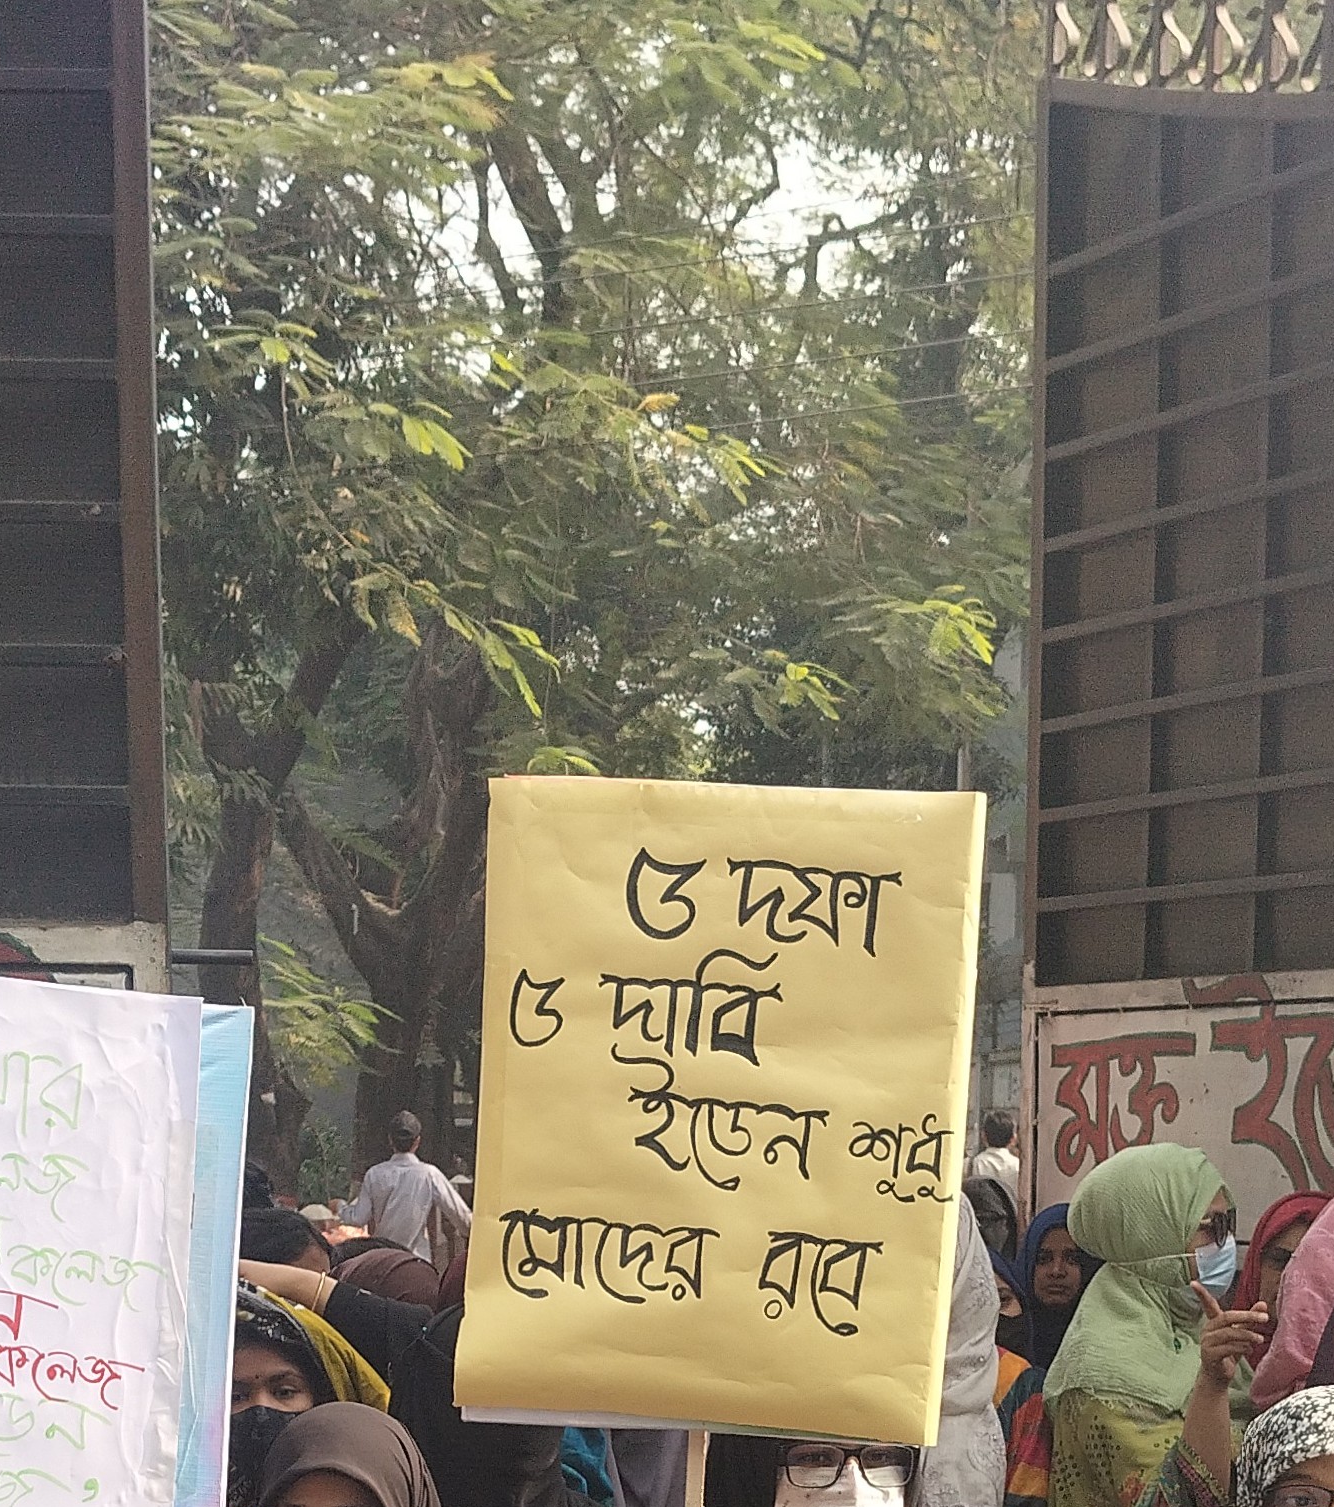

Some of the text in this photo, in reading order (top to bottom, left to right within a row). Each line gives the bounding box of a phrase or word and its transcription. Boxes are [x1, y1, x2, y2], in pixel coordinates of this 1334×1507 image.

[727, 857, 902, 957] দফা
[598, 949, 785, 1067] দাবি
[611, 1043, 954, 1202] ইডেন শুধু
[7, 1245, 165, 1312] কলেজ
[499, 1208, 883, 1336] মোদের রবে
